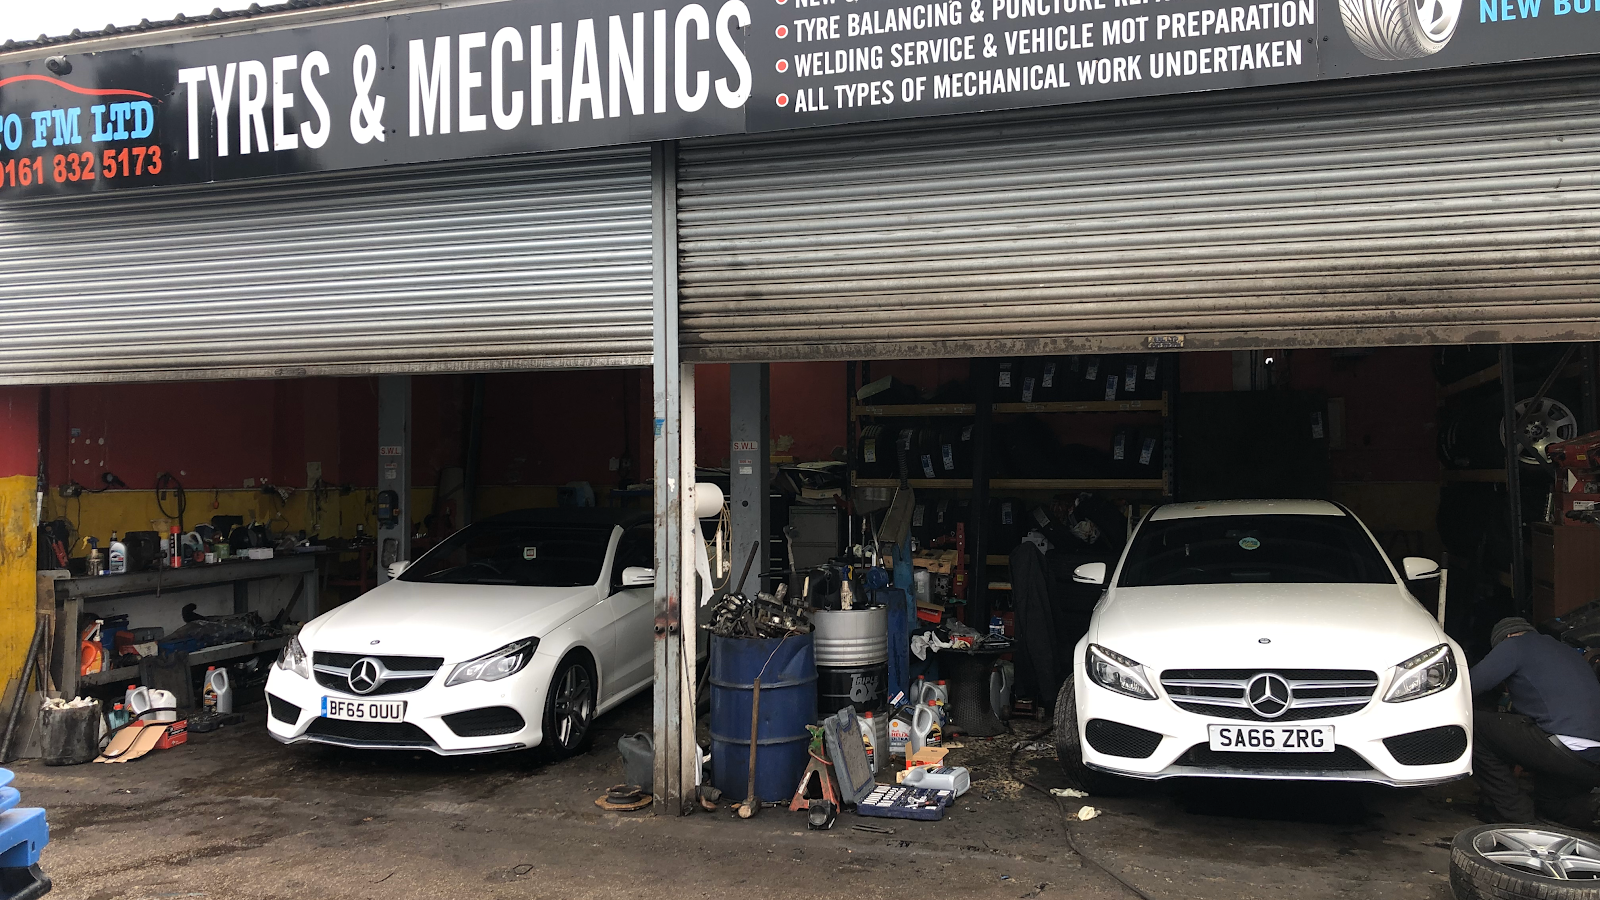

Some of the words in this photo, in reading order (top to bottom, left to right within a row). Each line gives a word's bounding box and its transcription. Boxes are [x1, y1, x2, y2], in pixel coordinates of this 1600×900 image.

[794, 15, 841, 43] TYRE
[847, 4, 962, 37] BALANCING
[969, 2, 985, 23] &
[1480, 0, 1541, 23] NEW
[794, 45, 883, 78] WELDING
[890, 35, 976, 68] SERVICE
[982, 33, 998, 58] &
[1004, 23, 1094, 56] VEHICLE
[1102, 16, 1149, 46] MOT
[1156, 0, 1314, 41] PREPARATION
[178, 50, 331, 160] TYRES
[350, 44, 386, 144] &
[408, 0, 752, 137] MECHANICS
[794, 87, 829, 113] ALL
[834, 80, 895, 109] TYPES
[901, 76, 927, 103] OF
[933, 63, 1071, 100] MECHANICAL
[1077, 55, 1143, 86] WORK
[1149, 39, 1303, 79] UNDERTAKEN
[0, 113, 23, 151] O
[32, 107, 82, 149] FM
[91, 100, 154, 143] LTD
[53, 151, 95, 183] 832
[103, 145, 162, 179] 5173
[849, 682, 879, 704] QX
[850, 673, 879, 687] TRIPLE
[329, 700, 365, 718] BF65
[369, 703, 401, 719] OUU
[1219, 728, 1275, 748] SA66
[1281, 729, 1324, 748] ZRG
